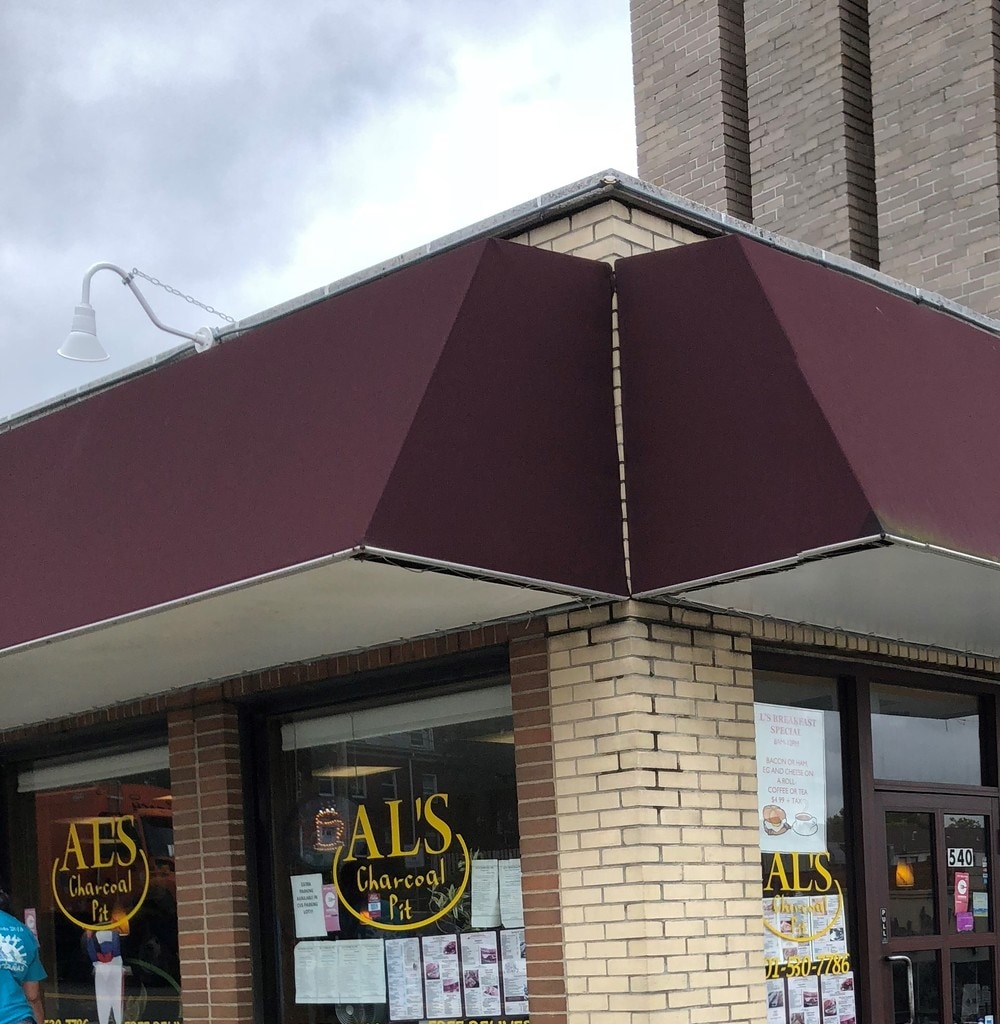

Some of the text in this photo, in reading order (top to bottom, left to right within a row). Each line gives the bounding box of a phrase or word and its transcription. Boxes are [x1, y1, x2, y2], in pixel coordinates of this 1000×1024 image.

[770, 725, 801, 737] SPECIAL
[773, 713, 817, 727] BREAKFAST
[766, 757, 787, 765] BACON
[771, 766, 784, 775] AND
[785, 768, 804, 776] CHEESE
[768, 786, 789, 795] COFFEE
[798, 788, 808, 796] TEA
[343, 793, 452, 862] AL'S
[59, 815, 137, 872] AL'S
[949, 849, 973, 866] 540
[357, 858, 445, 892] Charcoal
[764, 851, 833, 892] AL'S
[69, 869, 132, 897] Charcoal
[92, 899, 109, 922] Pit
[389, 893, 413, 920] Pit
[772, 894, 828, 915] Charcoal
